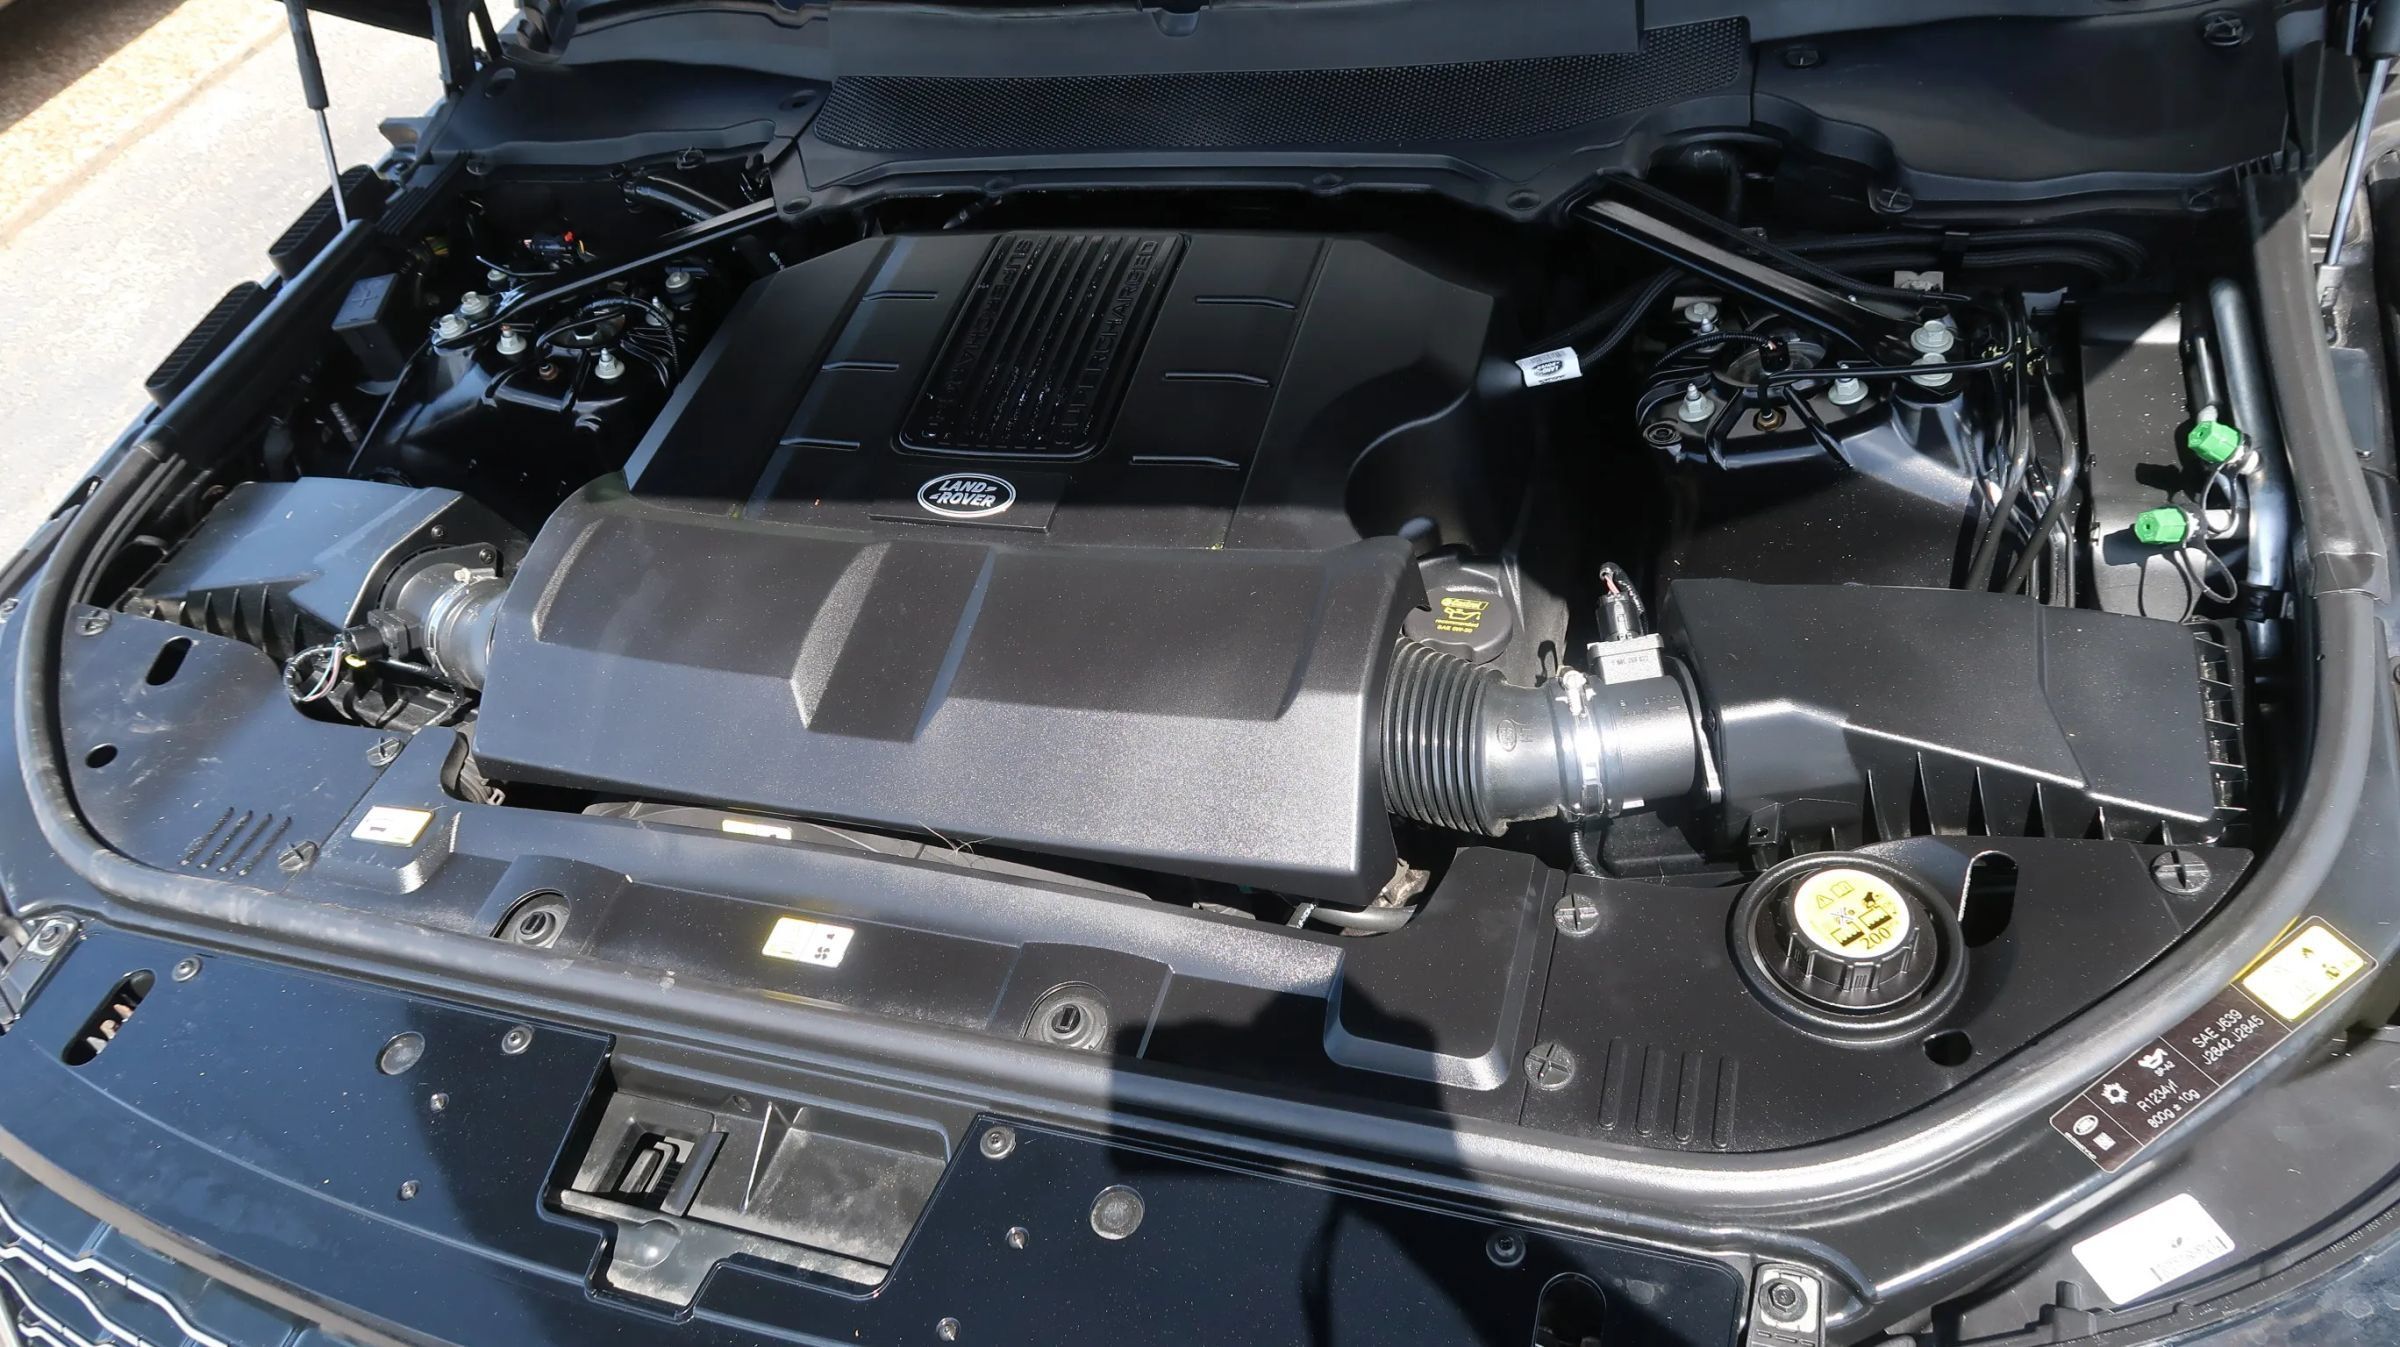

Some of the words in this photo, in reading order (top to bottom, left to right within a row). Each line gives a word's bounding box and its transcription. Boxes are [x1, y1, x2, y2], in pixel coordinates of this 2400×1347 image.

[1055, 239, 1158, 445] SUPERCHARGED
[936, 491, 997, 507] ROVER
[938, 480, 987, 493] LAND
[1860, 927, 1891, 950] 200
[2192, 1026, 2220, 1049] SAE
[2215, 1008, 2243, 1033] J639
[2201, 1037, 2236, 1066] J2842
[2232, 1014, 2265, 1043] J2845
[2136, 1078, 2180, 1113] R1234yf
[2147, 1108, 2176, 1129] 800g
[2178, 1088, 2201, 1105] 10g
